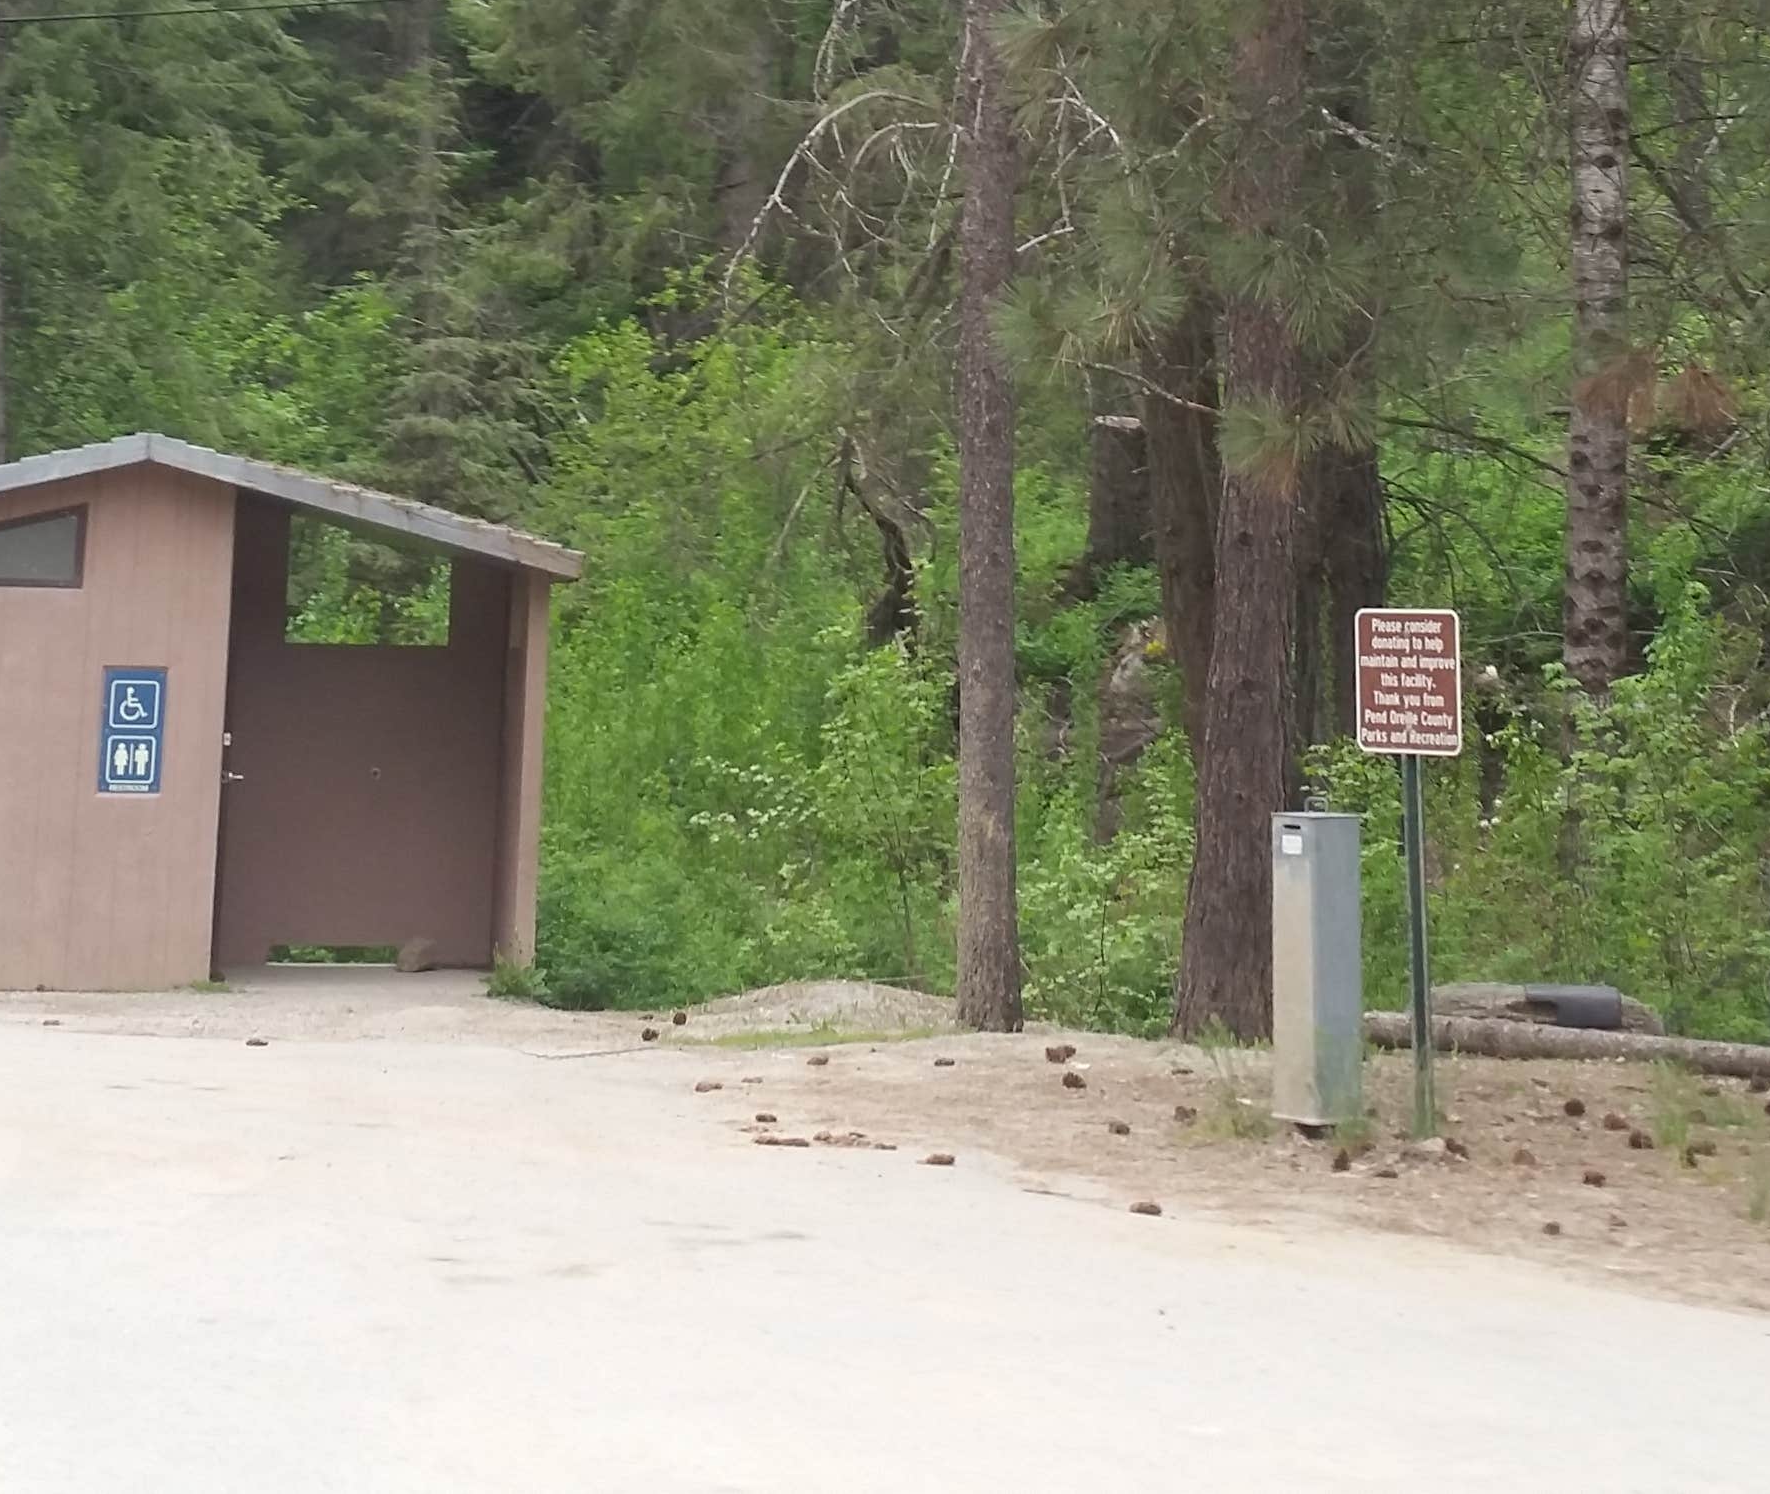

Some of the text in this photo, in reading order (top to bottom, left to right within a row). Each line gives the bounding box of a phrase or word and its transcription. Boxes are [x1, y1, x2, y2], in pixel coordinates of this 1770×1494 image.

[1371, 618, 1442, 634] Please consider
[1371, 636, 1444, 653] donating to help
[1360, 654, 1456, 672] maintain and improve
[1381, 673, 1436, 691] this facility.
[1373, 691, 1445, 709] Thank you from
[1364, 709, 1387, 724] Pend
[1421, 711, 1454, 730] County
[1361, 728, 1458, 746] Parks and Recreation
